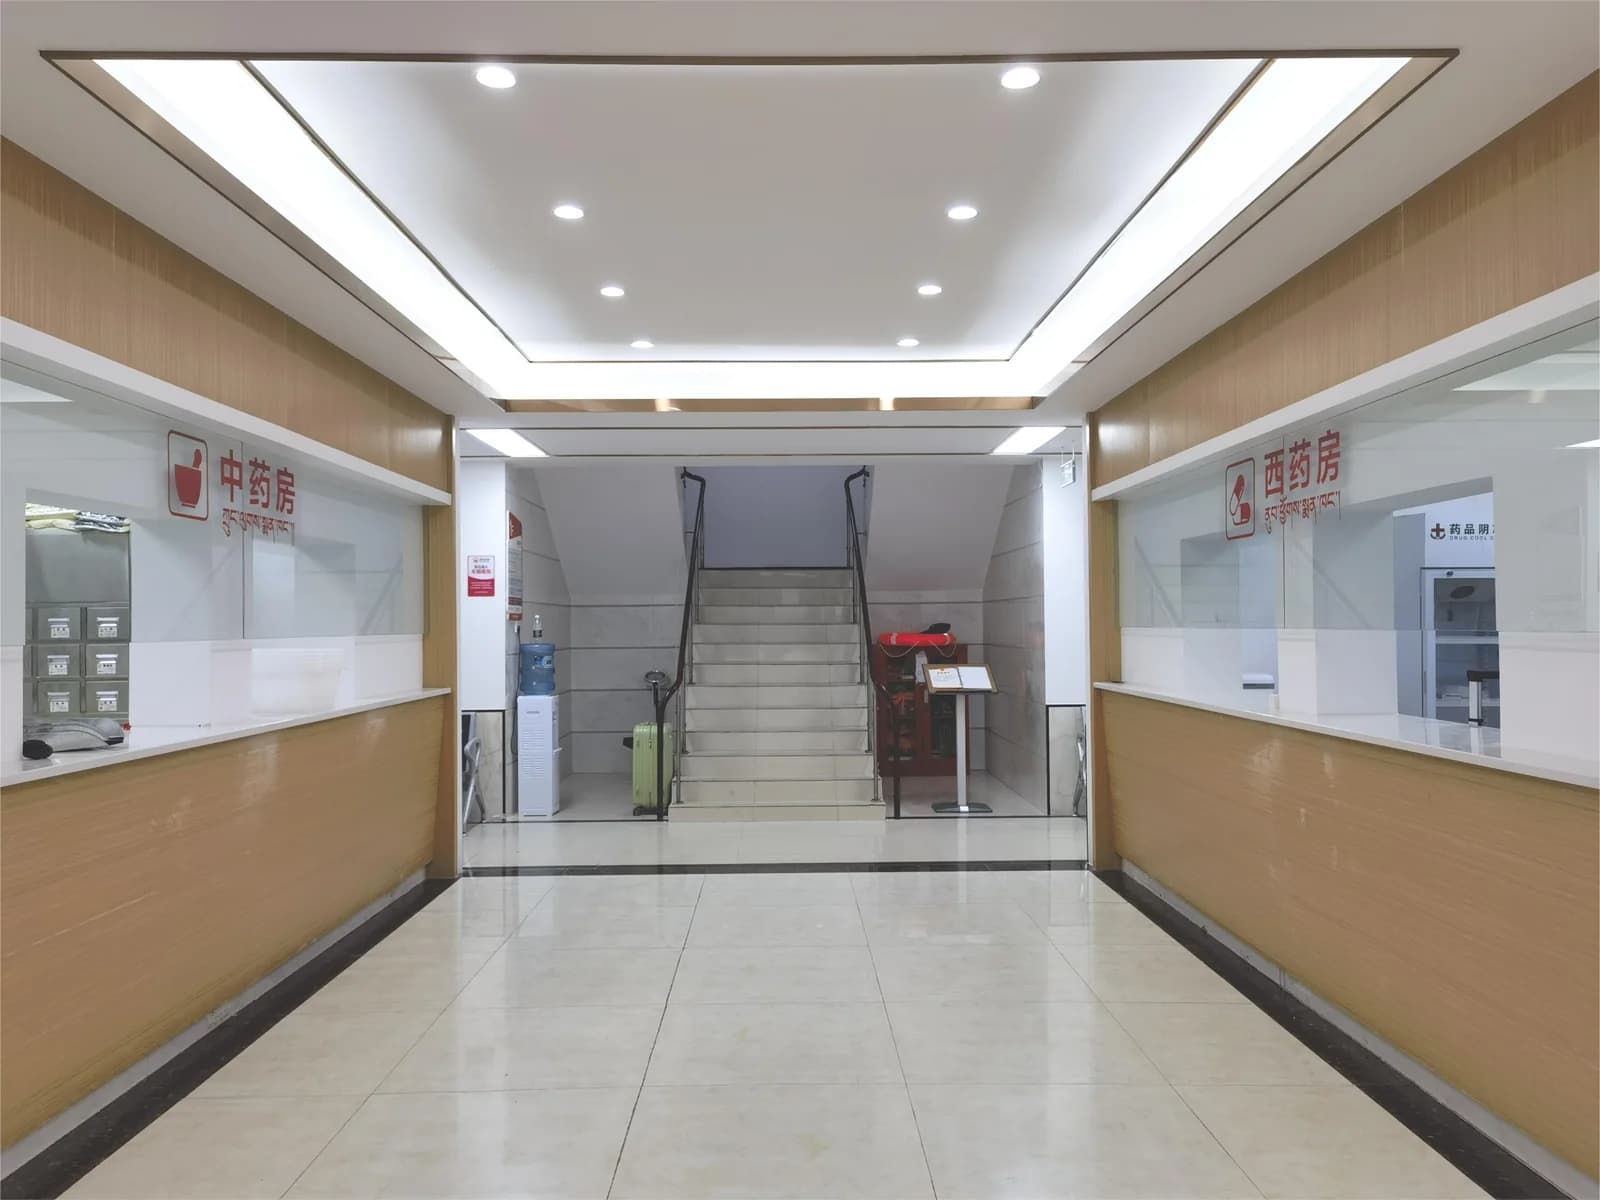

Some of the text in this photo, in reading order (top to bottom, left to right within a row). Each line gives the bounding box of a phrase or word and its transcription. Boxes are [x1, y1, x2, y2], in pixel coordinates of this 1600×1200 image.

[220, 449, 296, 515] 中药房
[1264, 429, 1341, 499] 西药房
[1449, 523, 1495, 535] 药品阴
